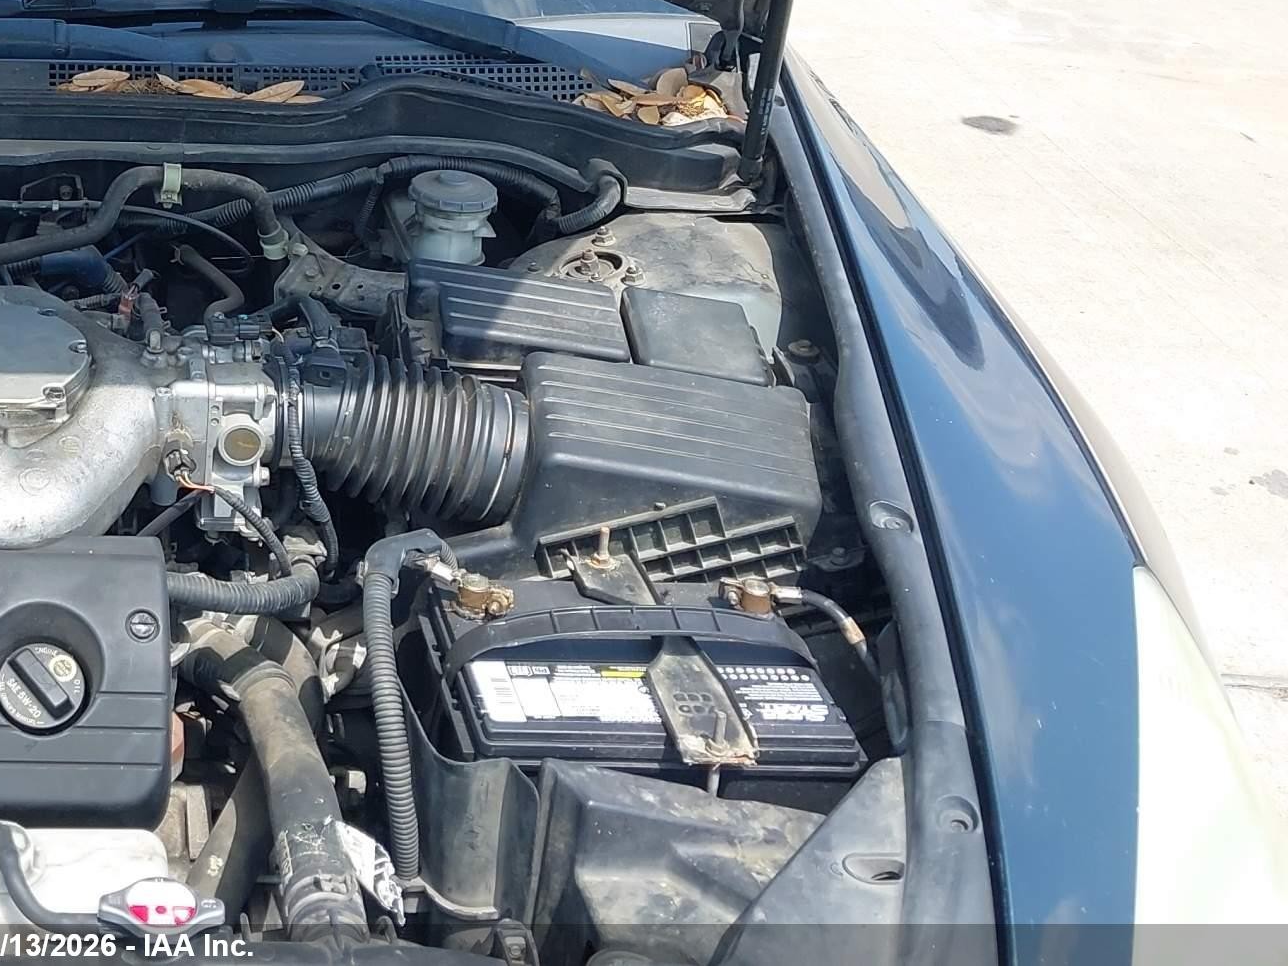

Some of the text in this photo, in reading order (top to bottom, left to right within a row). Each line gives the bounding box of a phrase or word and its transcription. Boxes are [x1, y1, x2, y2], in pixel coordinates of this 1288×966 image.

[7, 678, 42, 718] SAE 5W-20
[73, 679, 81, 694] OIL
